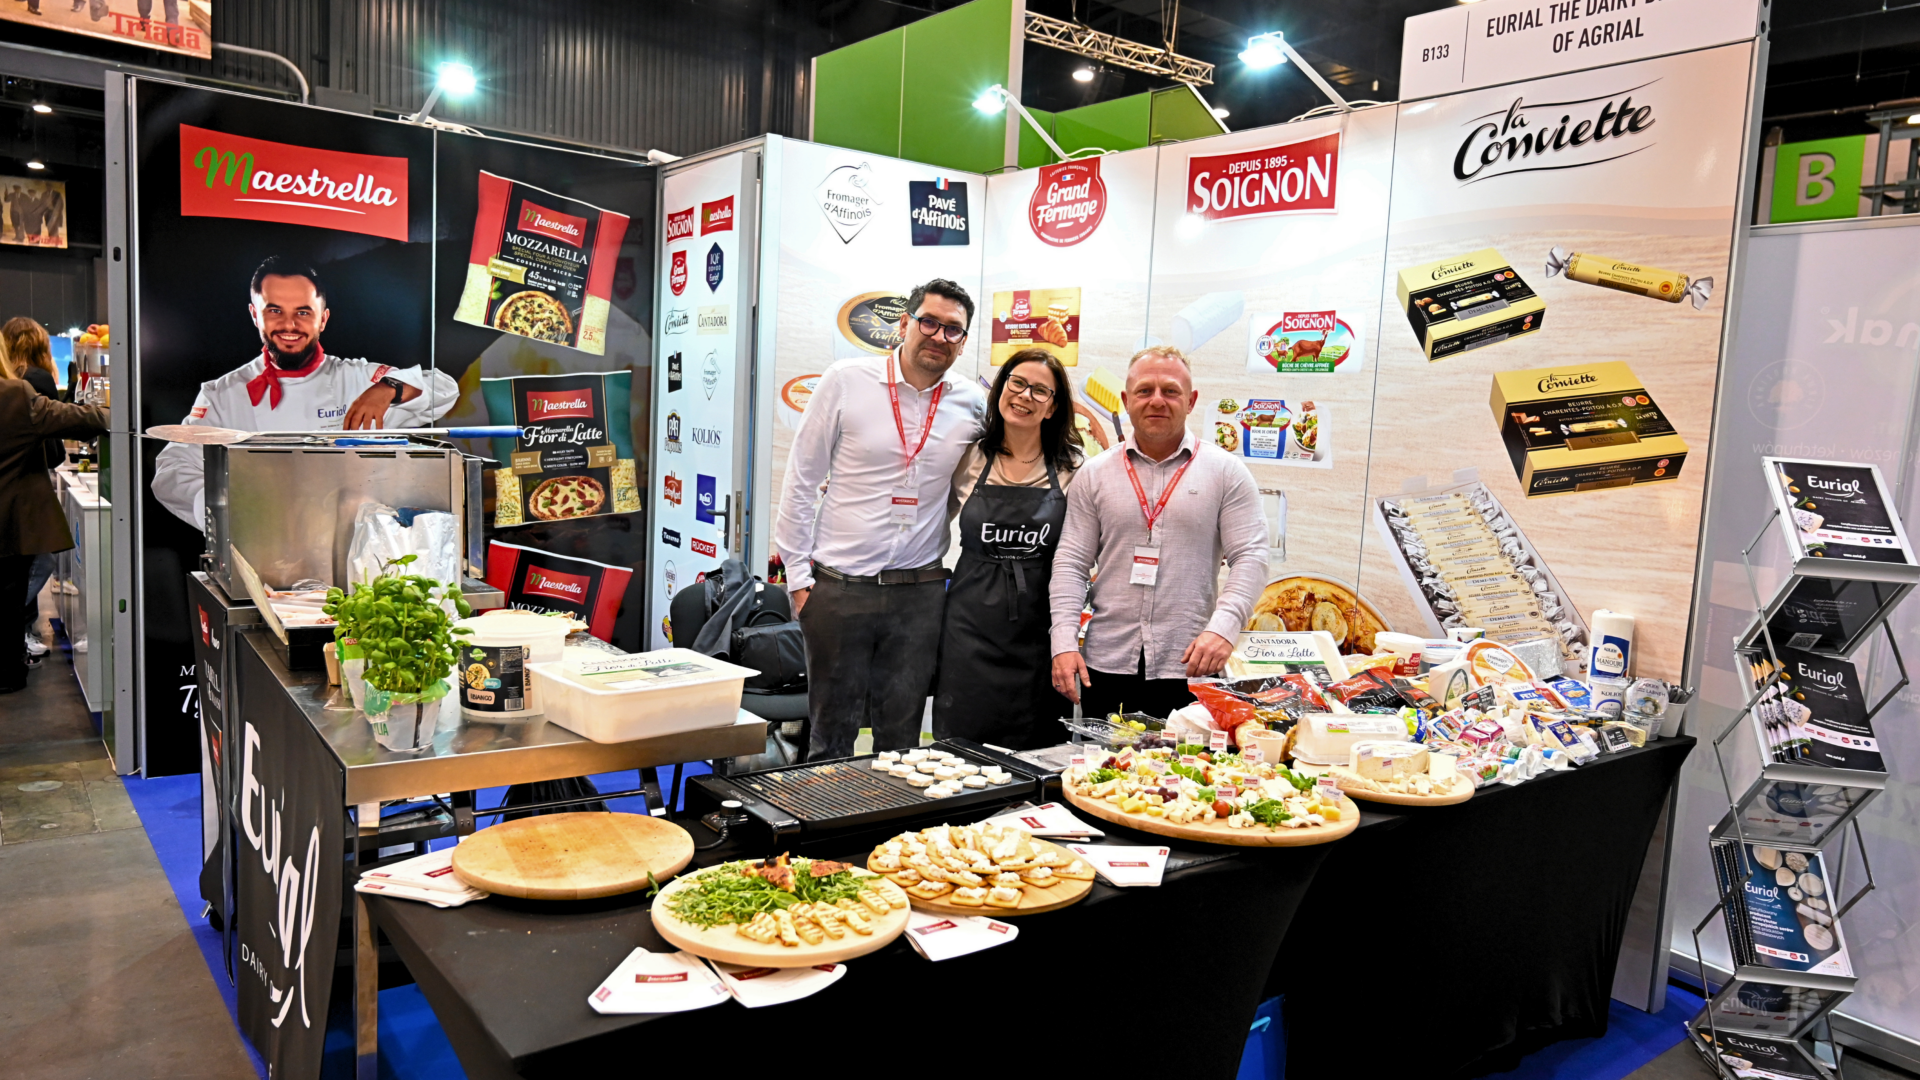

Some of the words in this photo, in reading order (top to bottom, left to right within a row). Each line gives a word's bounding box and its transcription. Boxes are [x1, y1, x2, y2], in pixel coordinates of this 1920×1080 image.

[1486, 8, 1543, 38] EURIAL
[1549, 4, 1580, 24] THE
[1585, 0, 1637, 17] DAI
[1552, 33, 1574, 53] OF
[1578, 17, 1645, 49] AGRIAL
[1422, 44, 1450, 62] B133
[1453, 96, 1656, 181] Conviette
[1229, 159, 1261, 174] DEPUIS
[1264, 156, 1287, 169] 1895
[194, 145, 398, 208] Maestrella
[1192, 153, 1331, 214] SOIGNON
[1796, 152, 1837, 206] B
[827, 189, 869, 208] Fromager
[1046, 177, 1091, 206] Grand
[823, 201, 872, 221] d'Affinois
[928, 194, 956, 212] PAVÉ
[1036, 200, 1098, 227] Fermage
[525, 208, 580, 237] Maestrella
[667, 214, 693, 238] SOIGNON
[912, 207, 966, 231] d'Affinois
[505, 231, 588, 265] MOZZARELLA
[1431, 260, 1476, 282] Conviette
[1454, 280, 1474, 289] BEURRE
[697, 314, 727, 328] CANTADORA
[1284, 315, 1334, 330] SOIGNON
[1537, 373, 1599, 394] Conviette
[317, 404, 347, 419] Eurial
[532, 398, 588, 412] Maestrella
[1543, 404, 1605, 416] CHARENTES-POITOU
[1567, 400, 1594, 408] BEURRE
[522, 425, 558, 447] Fior
[568, 422, 603, 445] Latte
[1589, 436, 1614, 444] DOUX
[1807, 475, 1864, 494] Eurial
[981, 522, 1051, 546] Eurial
[530, 572, 583, 595] Maestrella
[511, 601, 587, 623] MOZZLA
[1249, 636, 1298, 645] CANTADORA
[1244, 645, 1277, 658] Fior
[1286, 647, 1316, 661] Latte
[1798, 662, 1847, 689] Eurial
[1520, 692, 1538, 700] FETA
[1744, 881, 1781, 900] Eurial
[241, 943, 268, 988] DAIRY
[1727, 1037, 1779, 1055] Eurial
